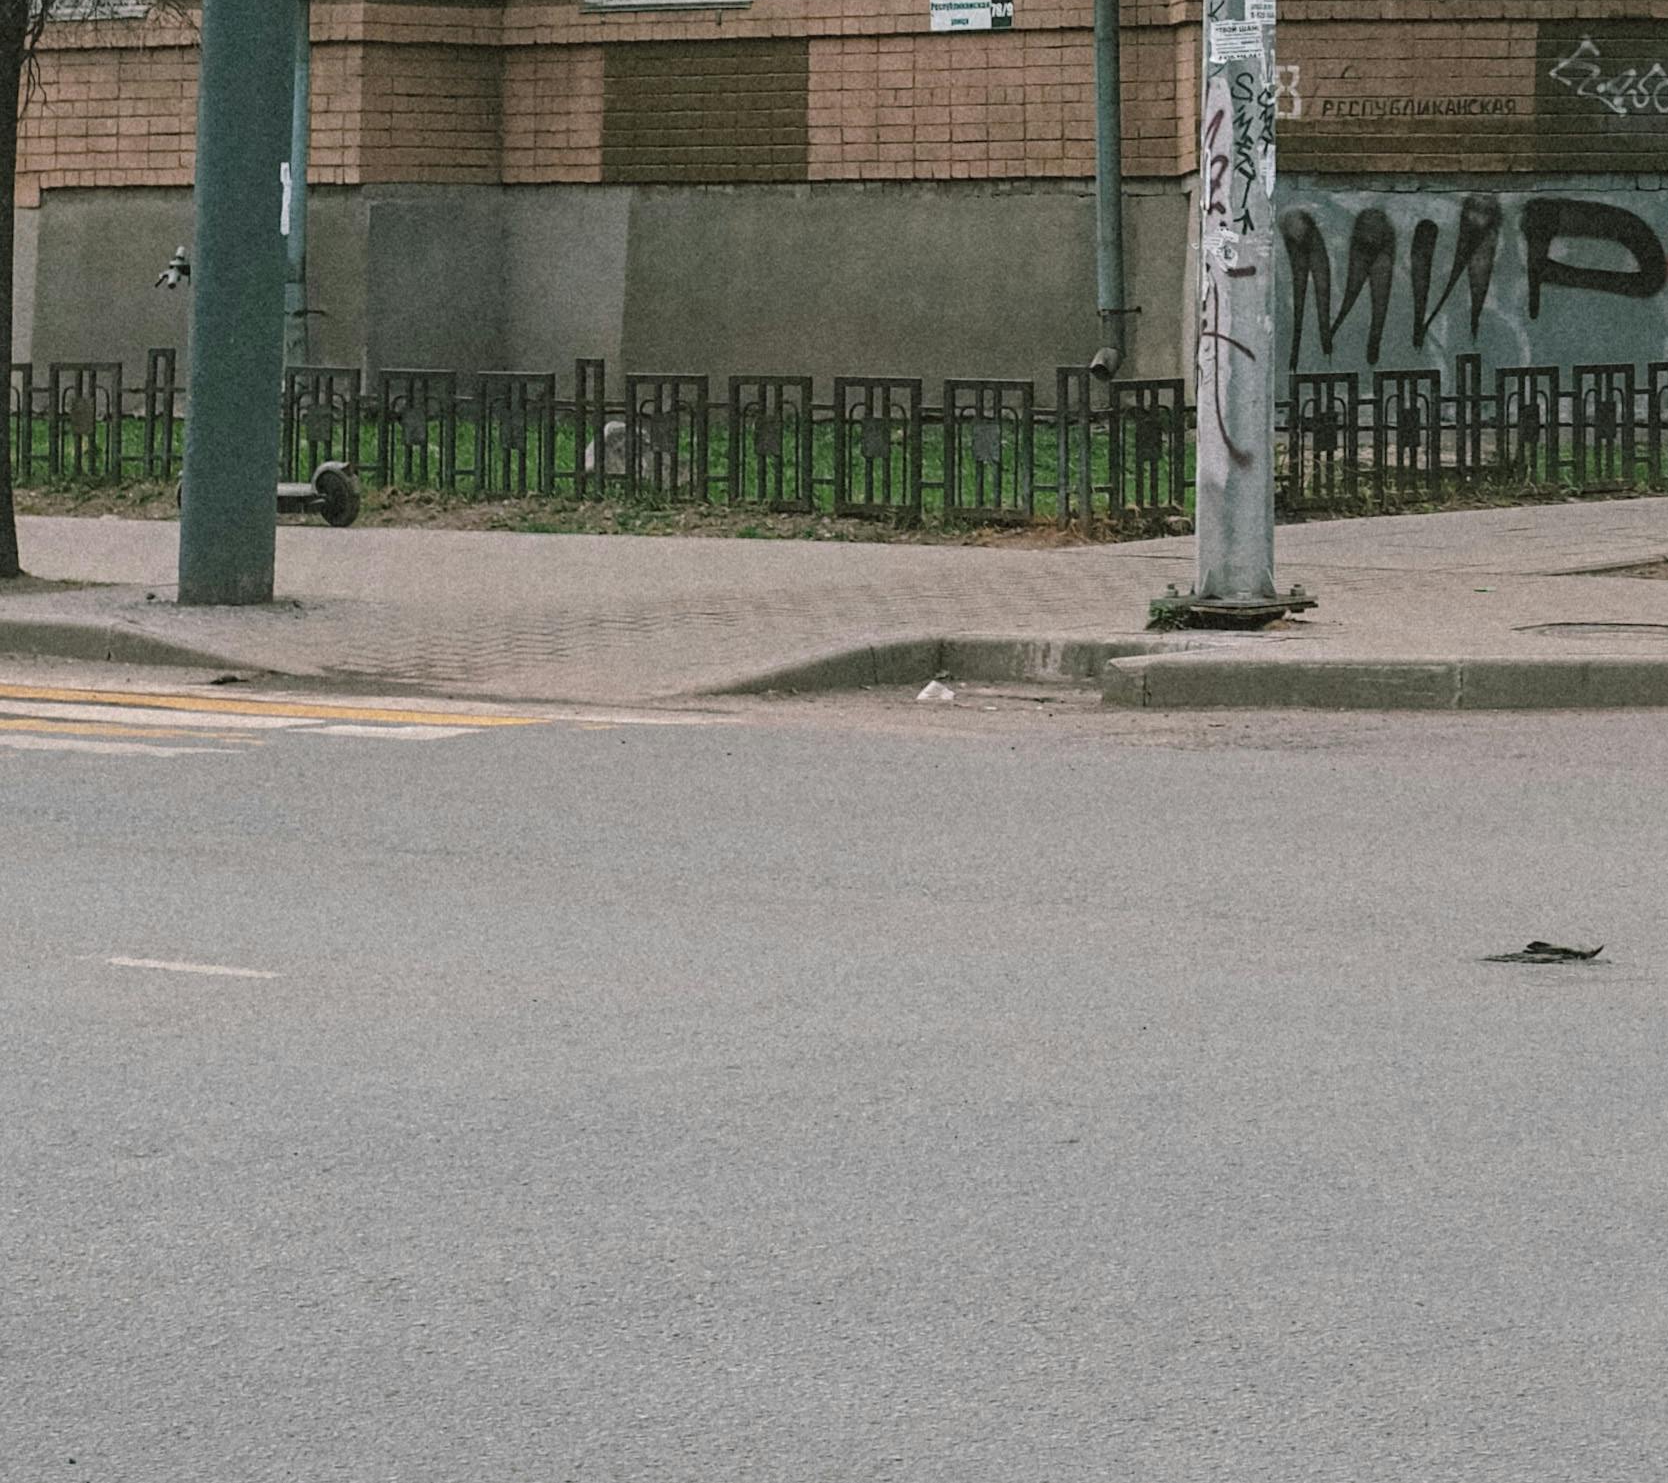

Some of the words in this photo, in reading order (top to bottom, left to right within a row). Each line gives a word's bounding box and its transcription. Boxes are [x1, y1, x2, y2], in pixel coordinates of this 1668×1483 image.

[991, 2, 1014, 18] 78/9
[1321, 98, 1517, 117] РЕСПУБЛИКАНСКАЯ
[1279, 195, 1668, 373] МИР
